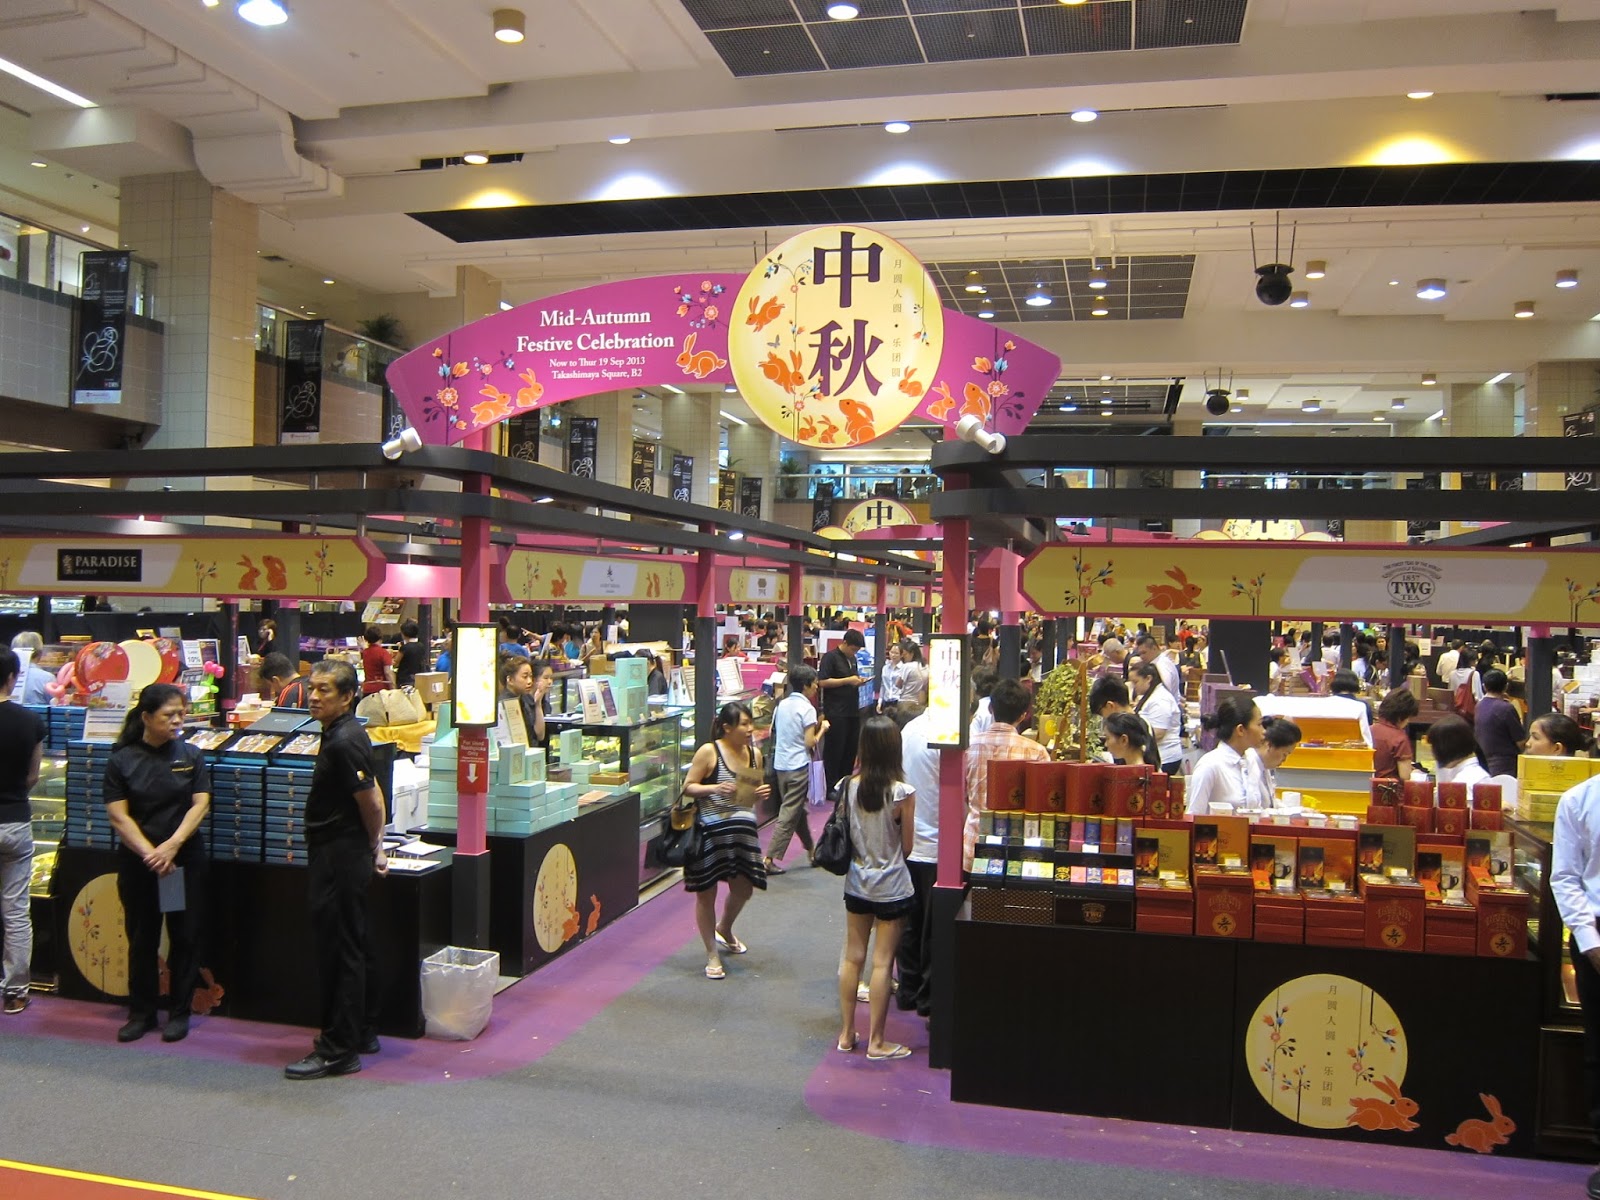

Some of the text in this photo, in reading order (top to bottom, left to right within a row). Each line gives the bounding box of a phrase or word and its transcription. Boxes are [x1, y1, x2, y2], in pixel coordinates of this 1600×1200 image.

[540, 308, 652, 327] Mid-Autumn
[808, 231, 884, 396] 中秋
[516, 332, 675, 352] Festive Celebration
[549, 356, 645, 367] Now to Thur 19 Sep 2013
[552, 368, 643, 380] Takashimaya Square, B2
[75, 555, 137, 568] PARADISE
[1391, 581, 1431, 595] TWG
